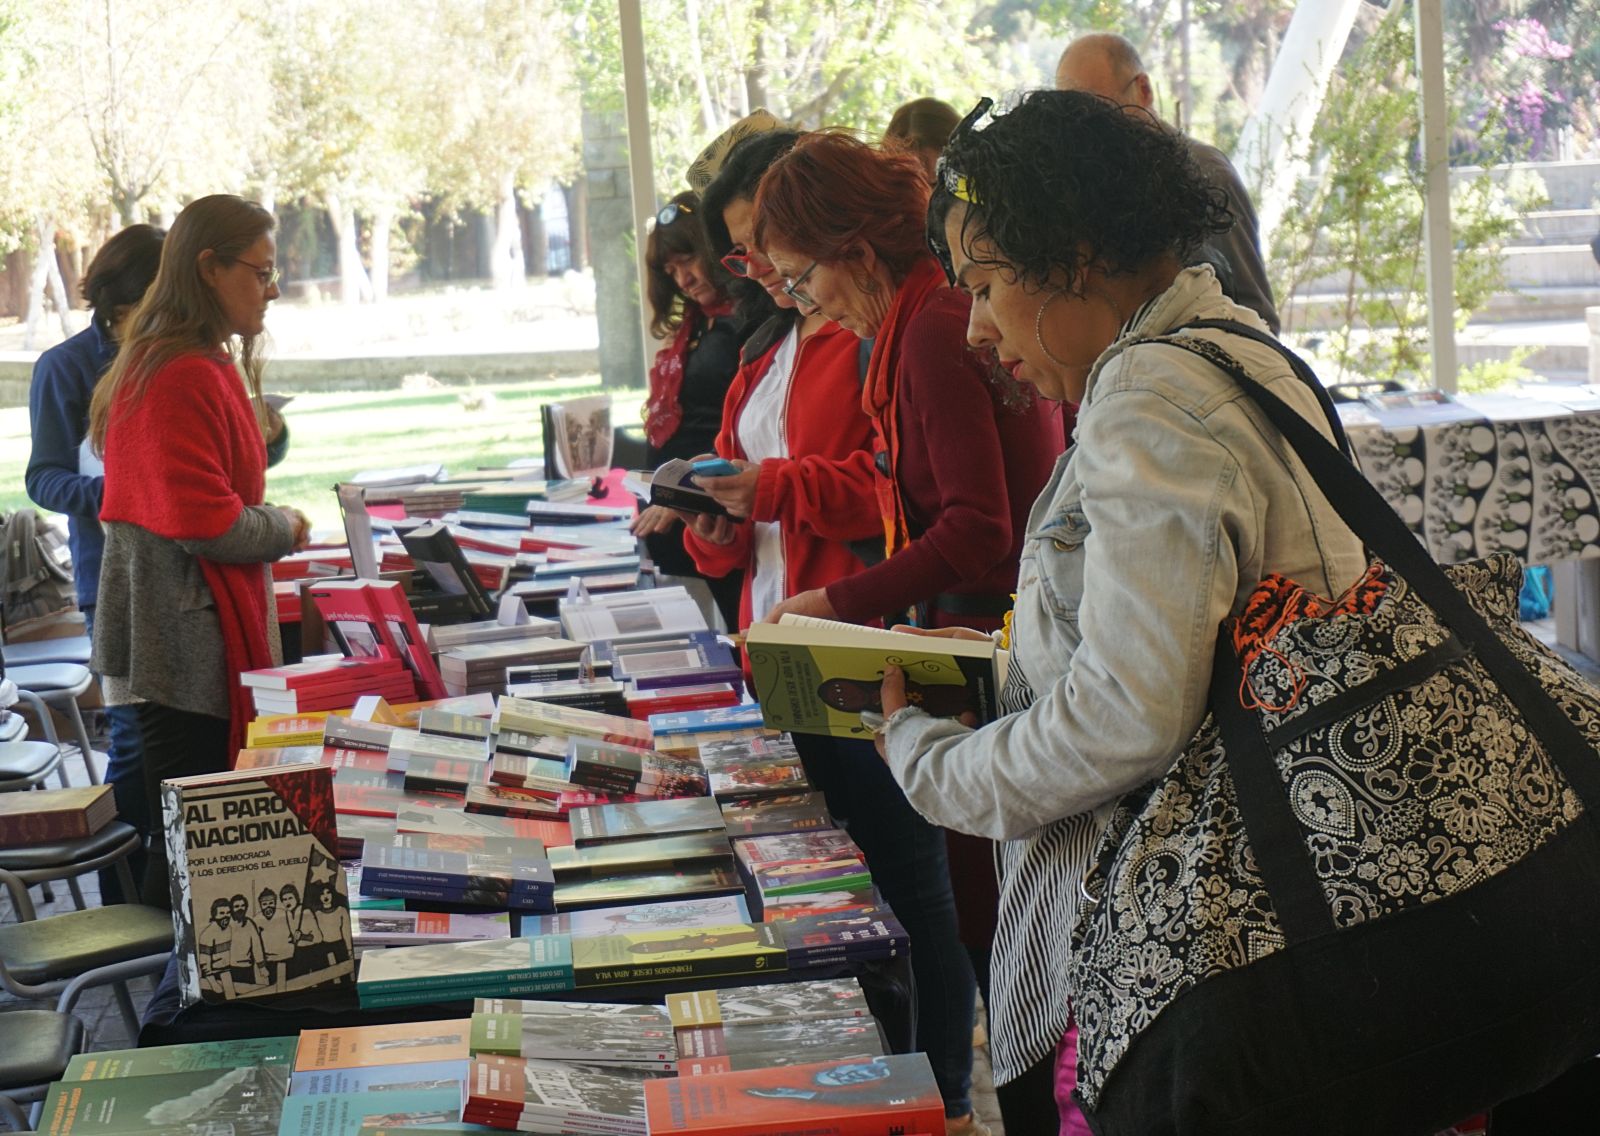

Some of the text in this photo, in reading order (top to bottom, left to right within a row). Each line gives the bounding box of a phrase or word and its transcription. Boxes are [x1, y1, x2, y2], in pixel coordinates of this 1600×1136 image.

[185, 796, 288, 825] AL PARO
[186, 818, 311, 850] NACIONAL
[188, 850, 271, 867] POR LA DEMOCRACIA
[197, 868, 214, 877] LOS
[216, 863, 259, 875] DERECHOS
[261, 860, 276, 870] DEL
[278, 856, 309, 867] PUEBLO
[632, 968, 652, 977] DESDE
[653, 965, 693, 976] FEMINISMOS
